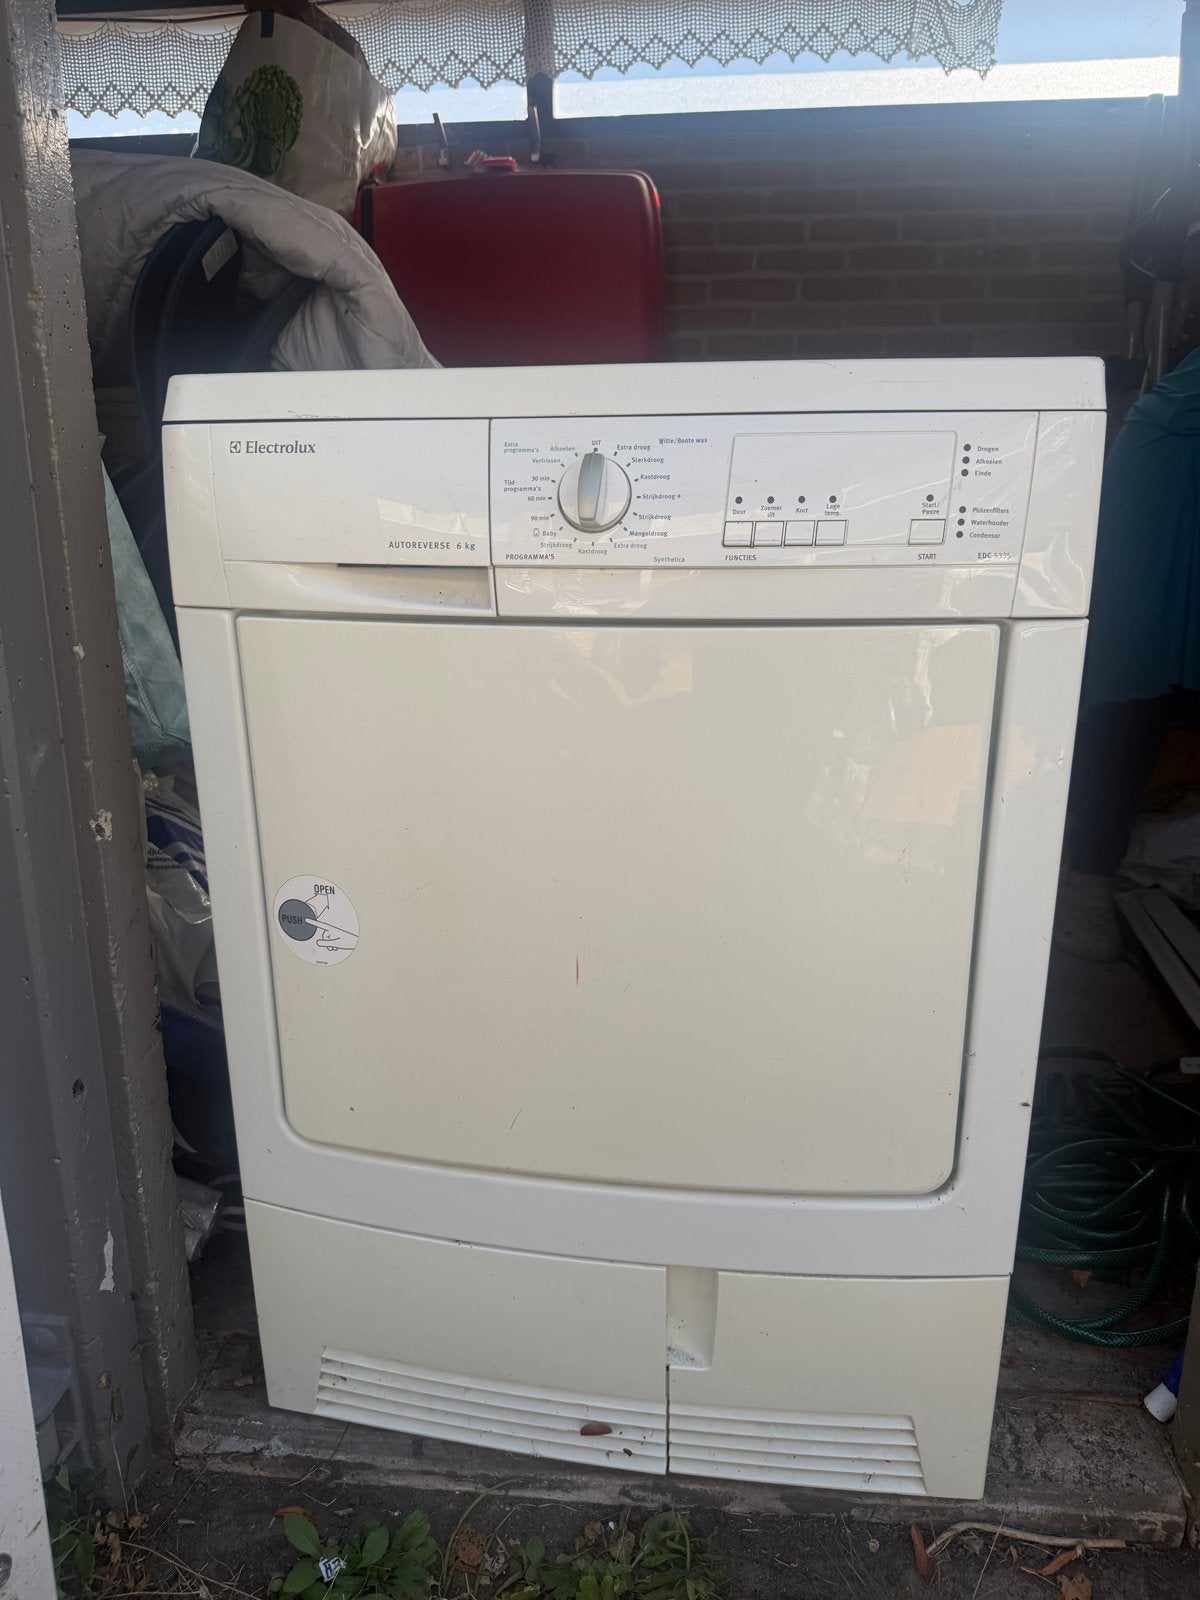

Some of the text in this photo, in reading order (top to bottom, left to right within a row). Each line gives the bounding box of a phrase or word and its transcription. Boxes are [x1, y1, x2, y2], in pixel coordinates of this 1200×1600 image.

[246, 440, 316, 454] Electrolux
[388, 541, 451, 549] AUTOREVERSE
[464, 542, 476, 551] kg
[314, 884, 335, 895] OPEN
[282, 914, 303, 925] PUSH
